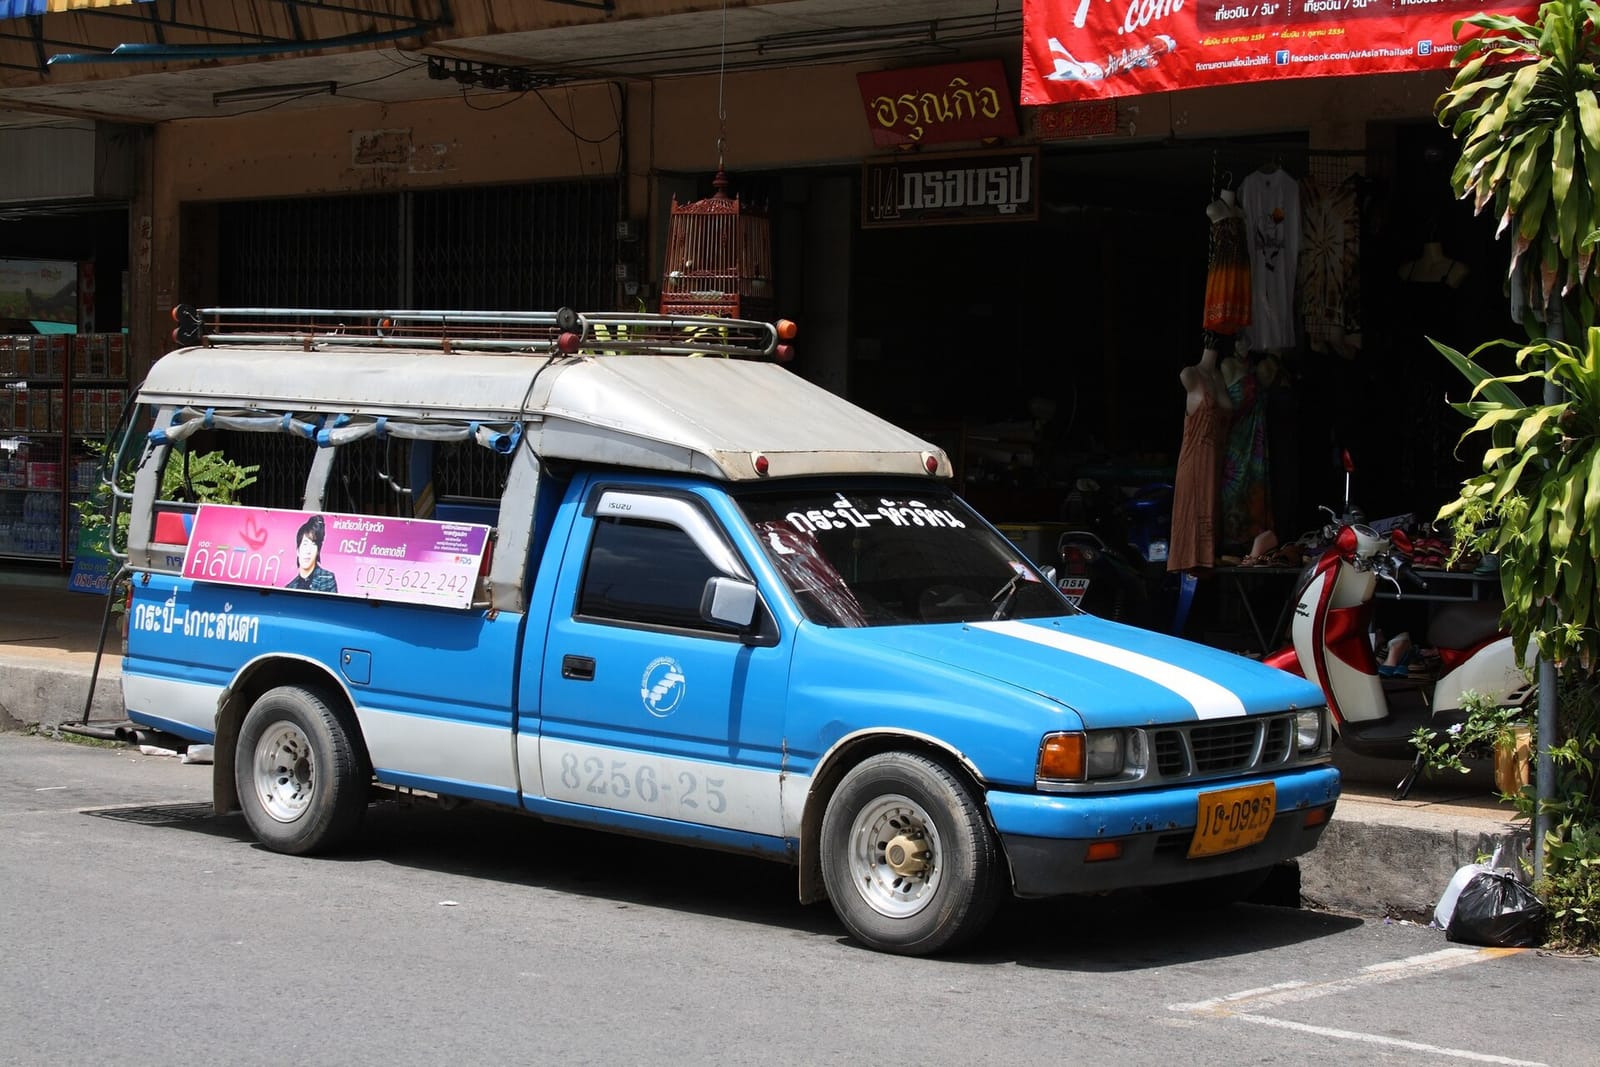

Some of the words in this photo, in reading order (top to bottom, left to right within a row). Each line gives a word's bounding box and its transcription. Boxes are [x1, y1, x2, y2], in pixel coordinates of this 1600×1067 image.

[1291, 48, 1413, 63] facebook.com/AirAsiaThailand
[870, 77, 1001, 141] อรุณกิจ
[786, 492, 966, 533] กระบี่-หัวหิน
[339, 532, 368, 554] กระบี่
[366, 566, 468, 594] 075-622-242
[134, 586, 259, 645] กระบี่-เกาะลันตา
[561, 752, 727, 814] 8256-25
